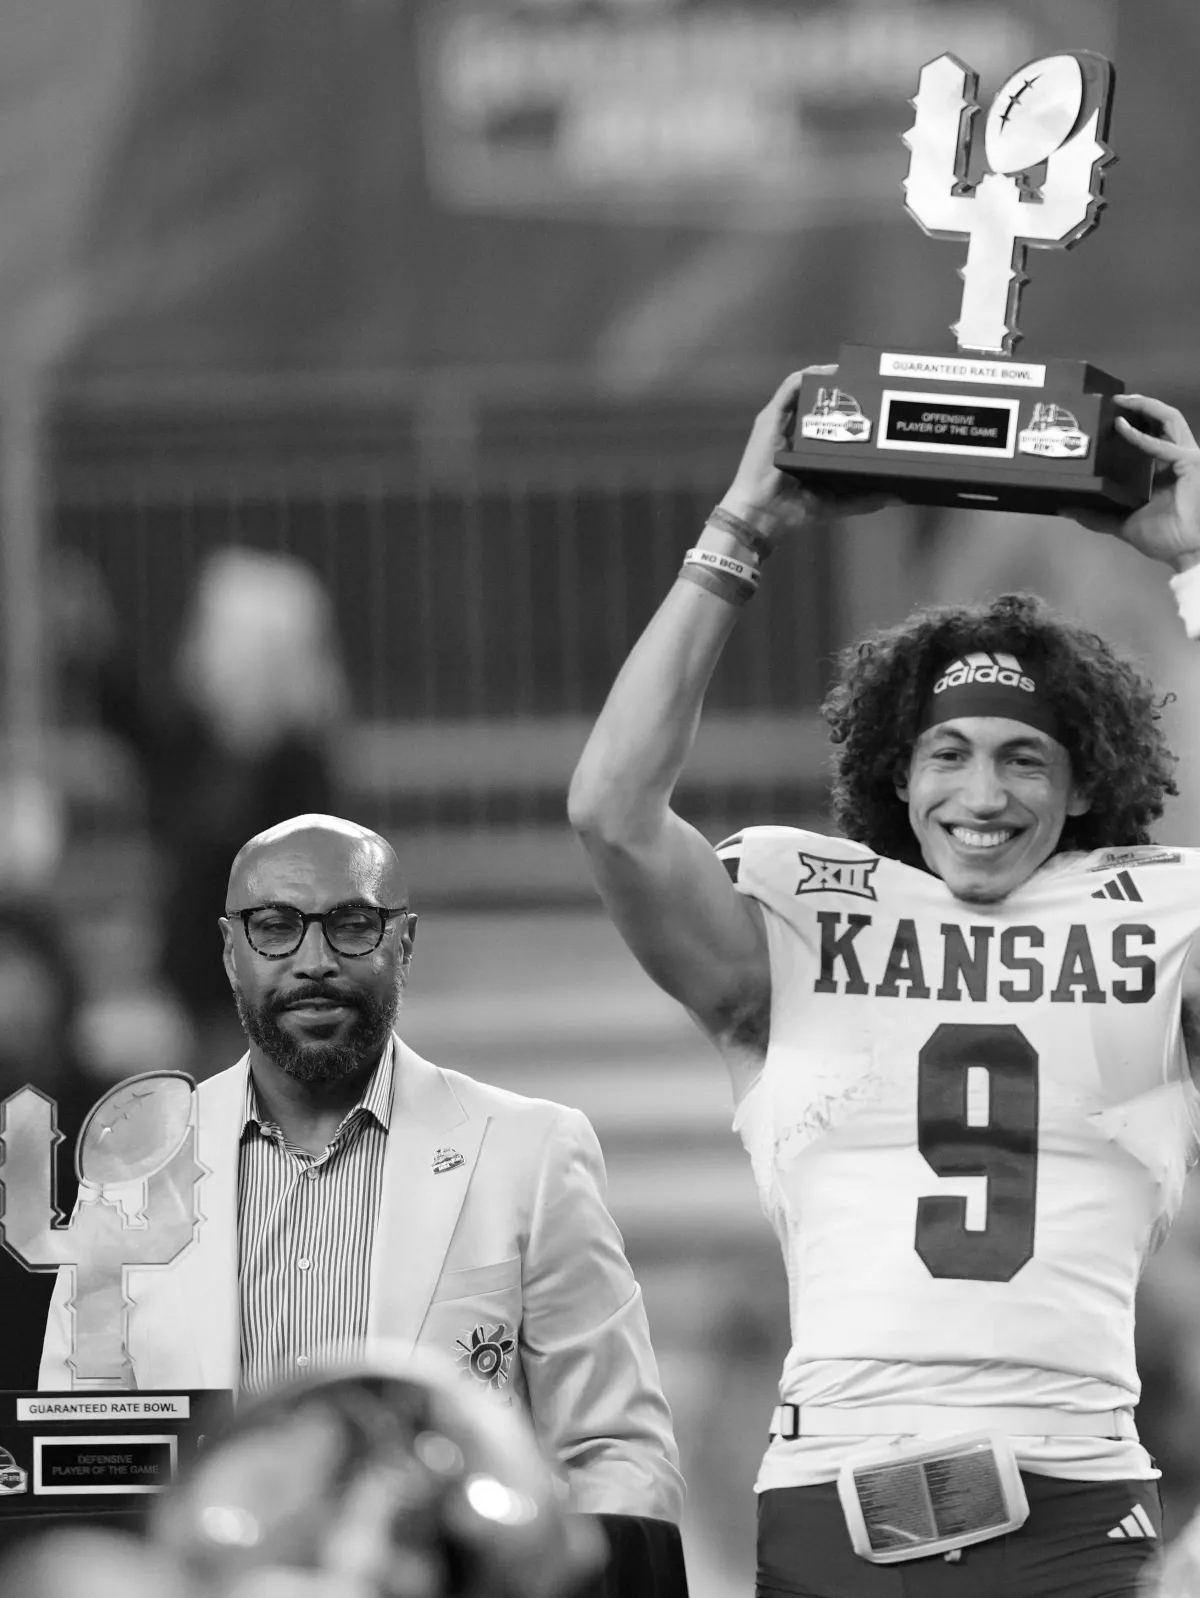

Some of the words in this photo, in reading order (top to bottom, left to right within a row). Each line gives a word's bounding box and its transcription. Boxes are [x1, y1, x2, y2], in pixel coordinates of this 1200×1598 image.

[893, 361, 967, 375] GUARANTEED
[970, 367, 997, 378] RATE
[1001, 369, 1033, 380] BOWL
[921, 412, 975, 426] OFFENSIVE
[896, 421, 933, 433] PLAYER
[934, 424, 948, 434] OF
[950, 425, 968, 436] THE
[970, 427, 998, 438] GAME
[700, 553, 718, 564] NO
[933, 665, 1036, 695] adidas
[814, 911, 1156, 1004] KANSAS
[914, 1023, 1039, 1282] 9
[29, 1403, 108, 1414] GUARANTEED
[111, 1402, 140, 1413] RATE
[143, 1402, 178, 1413] BOWL
[77, 1454, 134, 1465] DEFENSIVE
[52, 1466, 91, 1475] PLAYER
[92, 1466, 107, 1475] OF
[108, 1465, 127, 1475] THE
[129, 1464, 161, 1475] GAME
